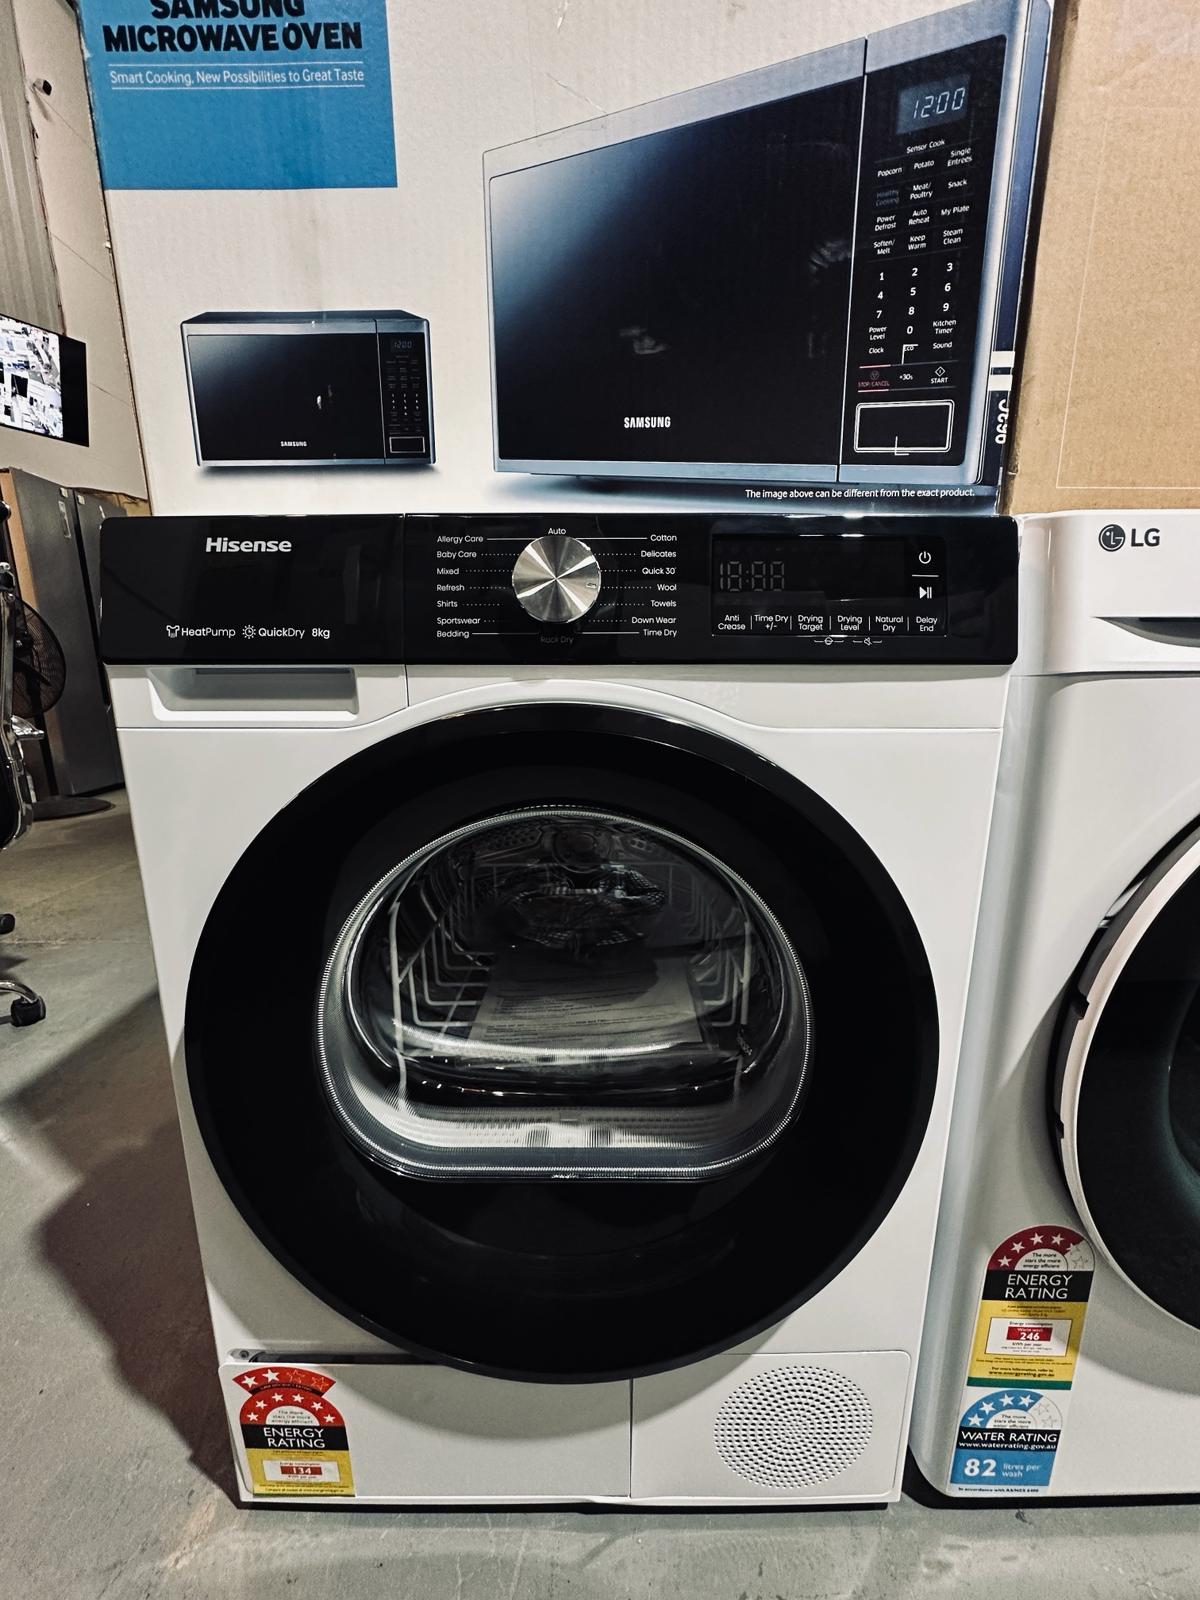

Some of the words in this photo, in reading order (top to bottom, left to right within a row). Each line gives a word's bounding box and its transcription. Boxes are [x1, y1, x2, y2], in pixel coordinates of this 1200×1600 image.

[152, 0, 305, 19] SAMSUNG
[102, 24, 279, 52] MICROWAVE
[281, 22, 362, 49] OVEN
[110, 71, 144, 84] Smart
[145, 70, 193, 86] Cooking,
[196, 71, 222, 83] New
[223, 69, 287, 83] Possibilities
[288, 71, 300, 82] to
[302, 69, 332, 82] Great
[334, 69, 364, 81] Taste
[913, 87, 966, 118] 12:00
[906, 143, 927, 154] Sensor
[929, 139, 945, 149] Cook
[950, 147, 971, 158] Single
[914, 160, 935, 170] Potato
[947, 155, 973, 167] Entrees
[877, 167, 903, 178] Popcorn
[912, 182, 932, 192] Meat/
[948, 178, 968, 189] Snack
[910, 190, 933, 200] Poultry
[912, 208, 928, 217] Auto
[941, 208, 951, 217] My
[953, 204, 970, 214] Plate
[876, 214, 896, 223] Power
[908, 216, 930, 226] Reheat
[875, 222, 897, 232] Defrost
[943, 228, 963, 237] Steam
[910, 234, 926, 243] Keep
[943, 236, 962, 245] Clean
[873, 239, 896, 249] Soften/
[908, 241, 927, 250] Warm
[877, 247, 891, 255] Melt
[946, 262, 953, 272] 3
[879, 273, 885, 281] 1
[911, 268, 918, 277] 2
[910, 287, 917, 296] 5
[944, 282, 951, 292] 6
[877, 291, 884, 300] 4
[908, 306, 915, 316] 8
[942, 302, 950, 312] 9
[876, 310, 883, 318] 7
[932, 319, 957, 327] Kitchen
[868, 326, 887, 334] Power
[906, 325, 914, 335] 0
[935, 327, 953, 335] Timer
[869, 333, 886, 341] Level
[624, 416, 671, 429] SAMSUNG
[745, 489, 761, 498] The
[762, 489, 788, 499] image
[789, 489, 814, 498] above
[831, 489, 842, 498] be
[843, 489, 878, 497] different
[880, 489, 900, 497] from
[901, 489, 915, 497] the
[916, 489, 939, 497] exact
[940, 488, 975, 498] product.
[548, 527, 566, 535] Auto
[436, 535, 463, 544] Allergy
[650, 534, 677, 542] Cotton
[1131, 528, 1160, 547] LG
[205, 537, 292, 552] Hisense
[436, 551, 457, 559] Baby
[641, 550, 677, 558] Delicates
[642, 567, 664, 575] Quick
[436, 600, 458, 608] Shirts
[436, 617, 481, 625] Sportswear
[775, 615, 789, 624] Dry
[797, 615, 824, 624] Drying
[837, 615, 863, 624] Drying
[875, 615, 904, 623] Natural
[916, 616, 938, 625] Delay
[765, 623, 778, 631] +/-
[798, 623, 824, 632] Target
[840, 623, 860, 631] Level
[882, 624, 896, 633] Dry
[919, 624, 934, 632] End
[181, 628, 236, 638] HeatPump
[258, 628, 305, 639] QuickDry
[311, 628, 331, 639] 8kg
[436, 630, 470, 639] Bedding
[664, 629, 677, 638] Dry
[1007, 1274, 1073, 1287] ENERGY
[1005, 1287, 1069, 1300] RATING
[1020, 1332, 1040, 1341] 246
[263, 1427, 325, 1438] ENERGY
[961, 1431, 1005, 1442] WATER
[1009, 1433, 1058, 1443] RATING
[267, 1438, 326, 1449] RATING
[959, 1442, 1056, 1450] www.waterrating.gov.au
[291, 1467, 312, 1475] 134
[964, 1458, 997, 1477] 82
[1026, 1463, 1041, 1472] per
